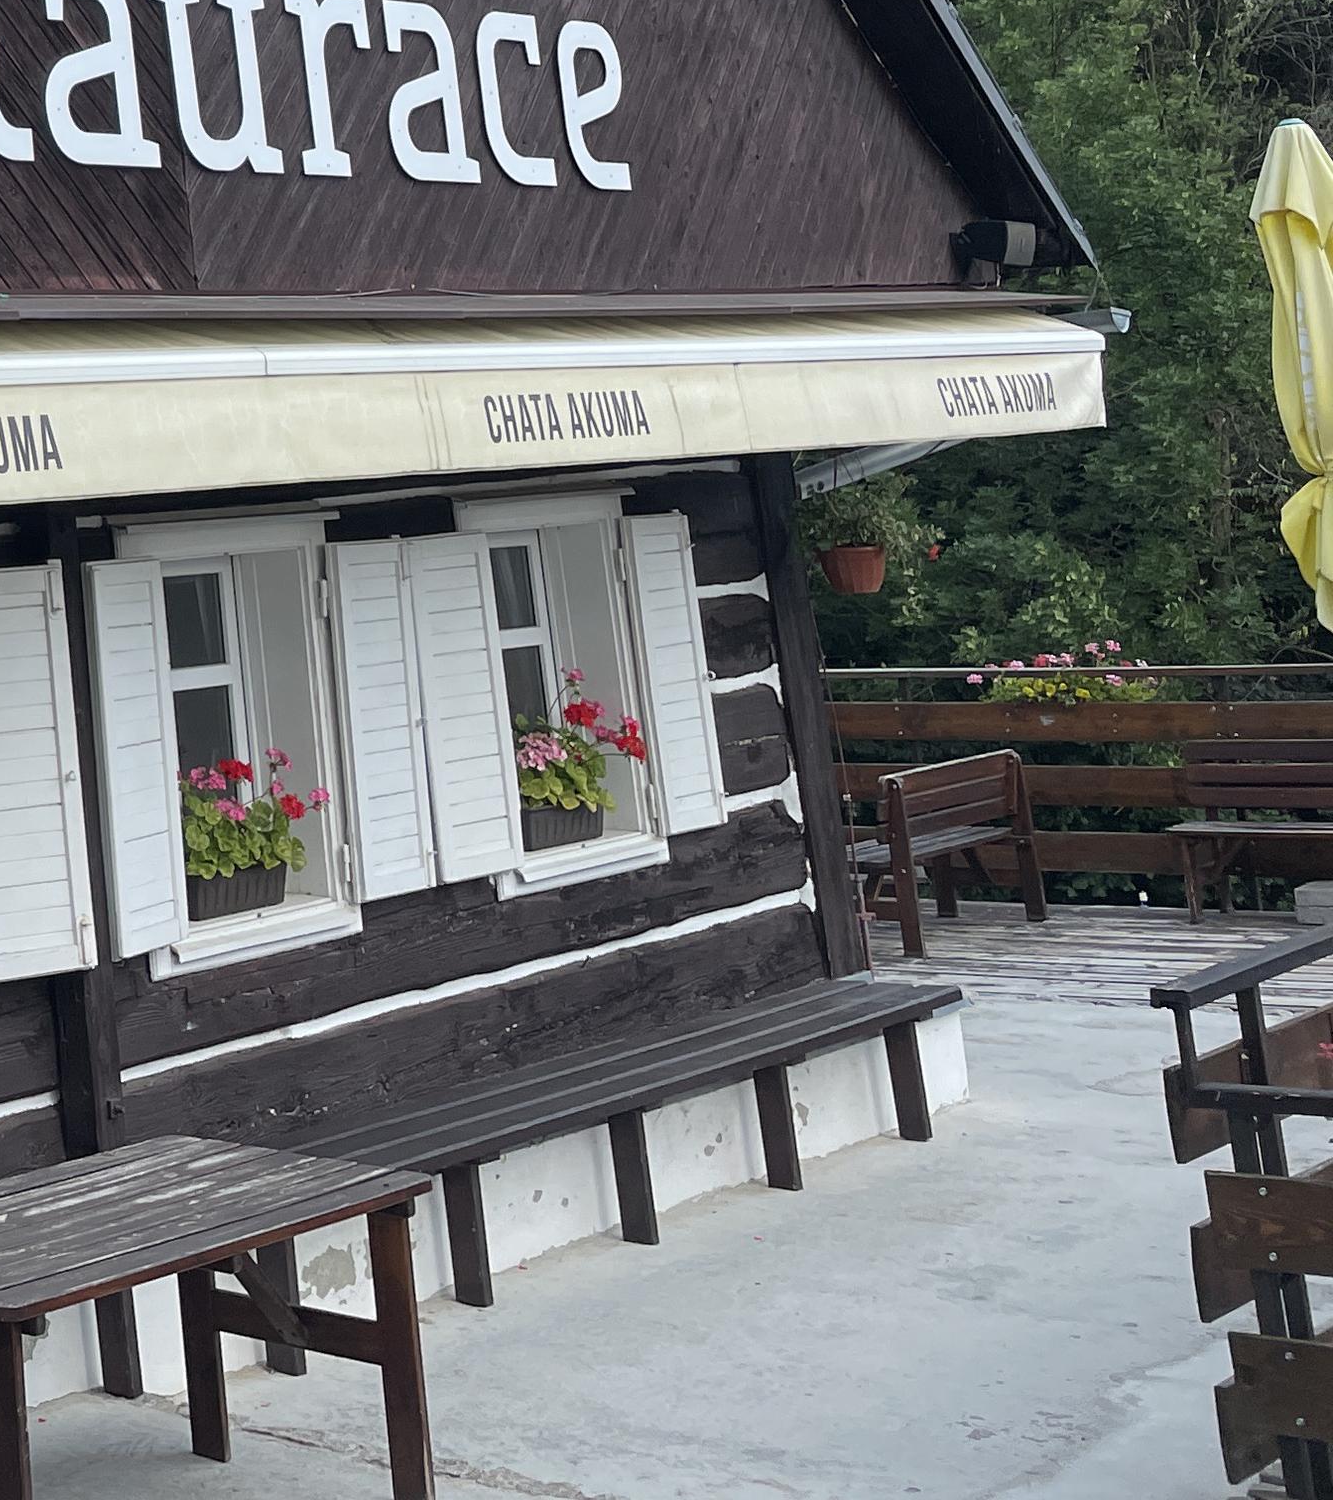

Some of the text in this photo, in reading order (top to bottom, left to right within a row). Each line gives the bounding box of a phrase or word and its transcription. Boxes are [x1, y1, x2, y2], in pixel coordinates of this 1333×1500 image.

[483, 390, 651, 444] CHATA AKUMA
[936, 372, 1058, 418] CHATA AKUMA
